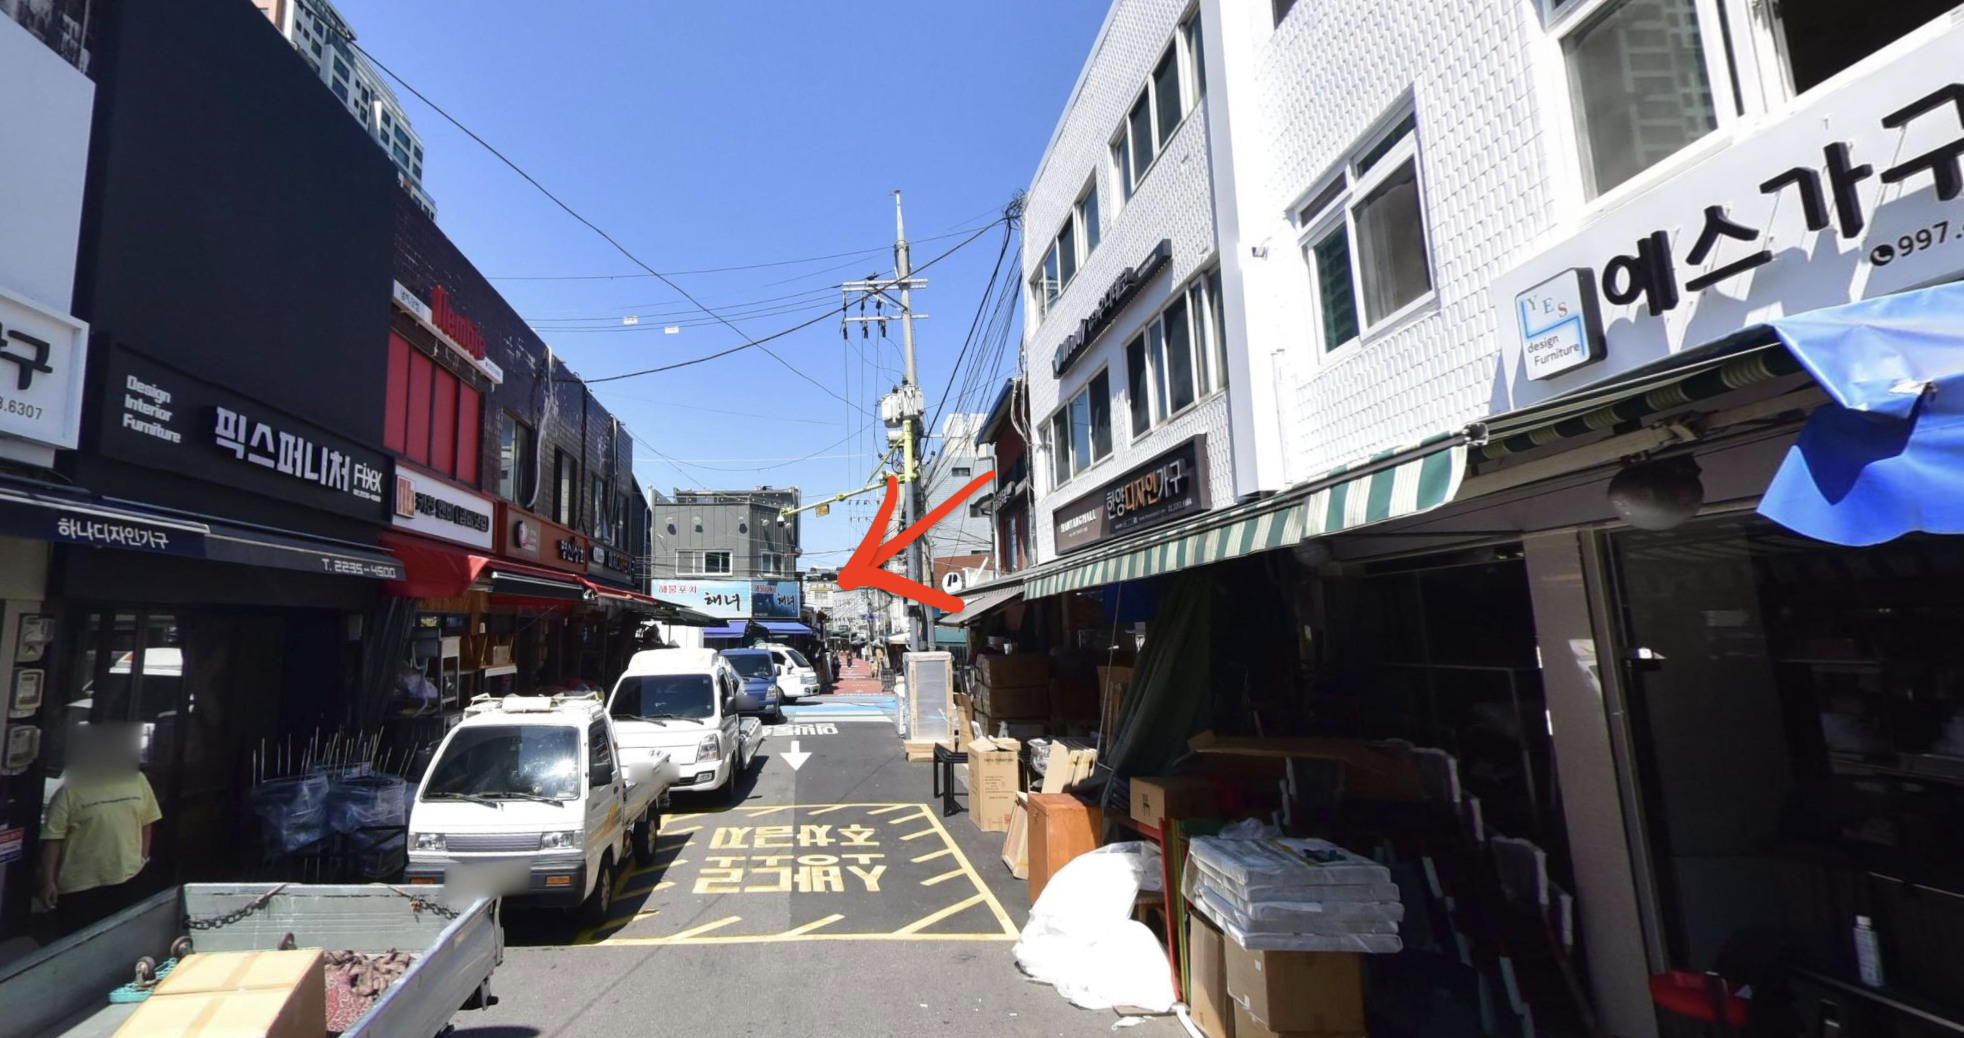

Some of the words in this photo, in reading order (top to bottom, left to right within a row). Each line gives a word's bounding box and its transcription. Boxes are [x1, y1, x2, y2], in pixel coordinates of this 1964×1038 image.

[1602, 83, 1964, 317] 예스가구
[1898, 221, 1964, 257] 997.
[1526, 294, 1568, 318] YES
[0, 321, 54, 391] 구
[1527, 335, 1560, 354] design
[1534, 343, 1580, 366] Furniture
[126, 375, 171, 404] Design
[125, 393, 173, 421] Interior
[123, 413, 181, 443] Furniture
[215, 406, 350, 492] 픽스퍼니처
[58, 518, 169, 549] 하나디자인가구
[334, 560, 397, 579] 2235-4500
[704, 592, 741, 612] 해녀
[762, 723, 839, 737] 일방통
[709, 824, 881, 850] 주차금지
[692, 853, 888, 894] 소방도로
